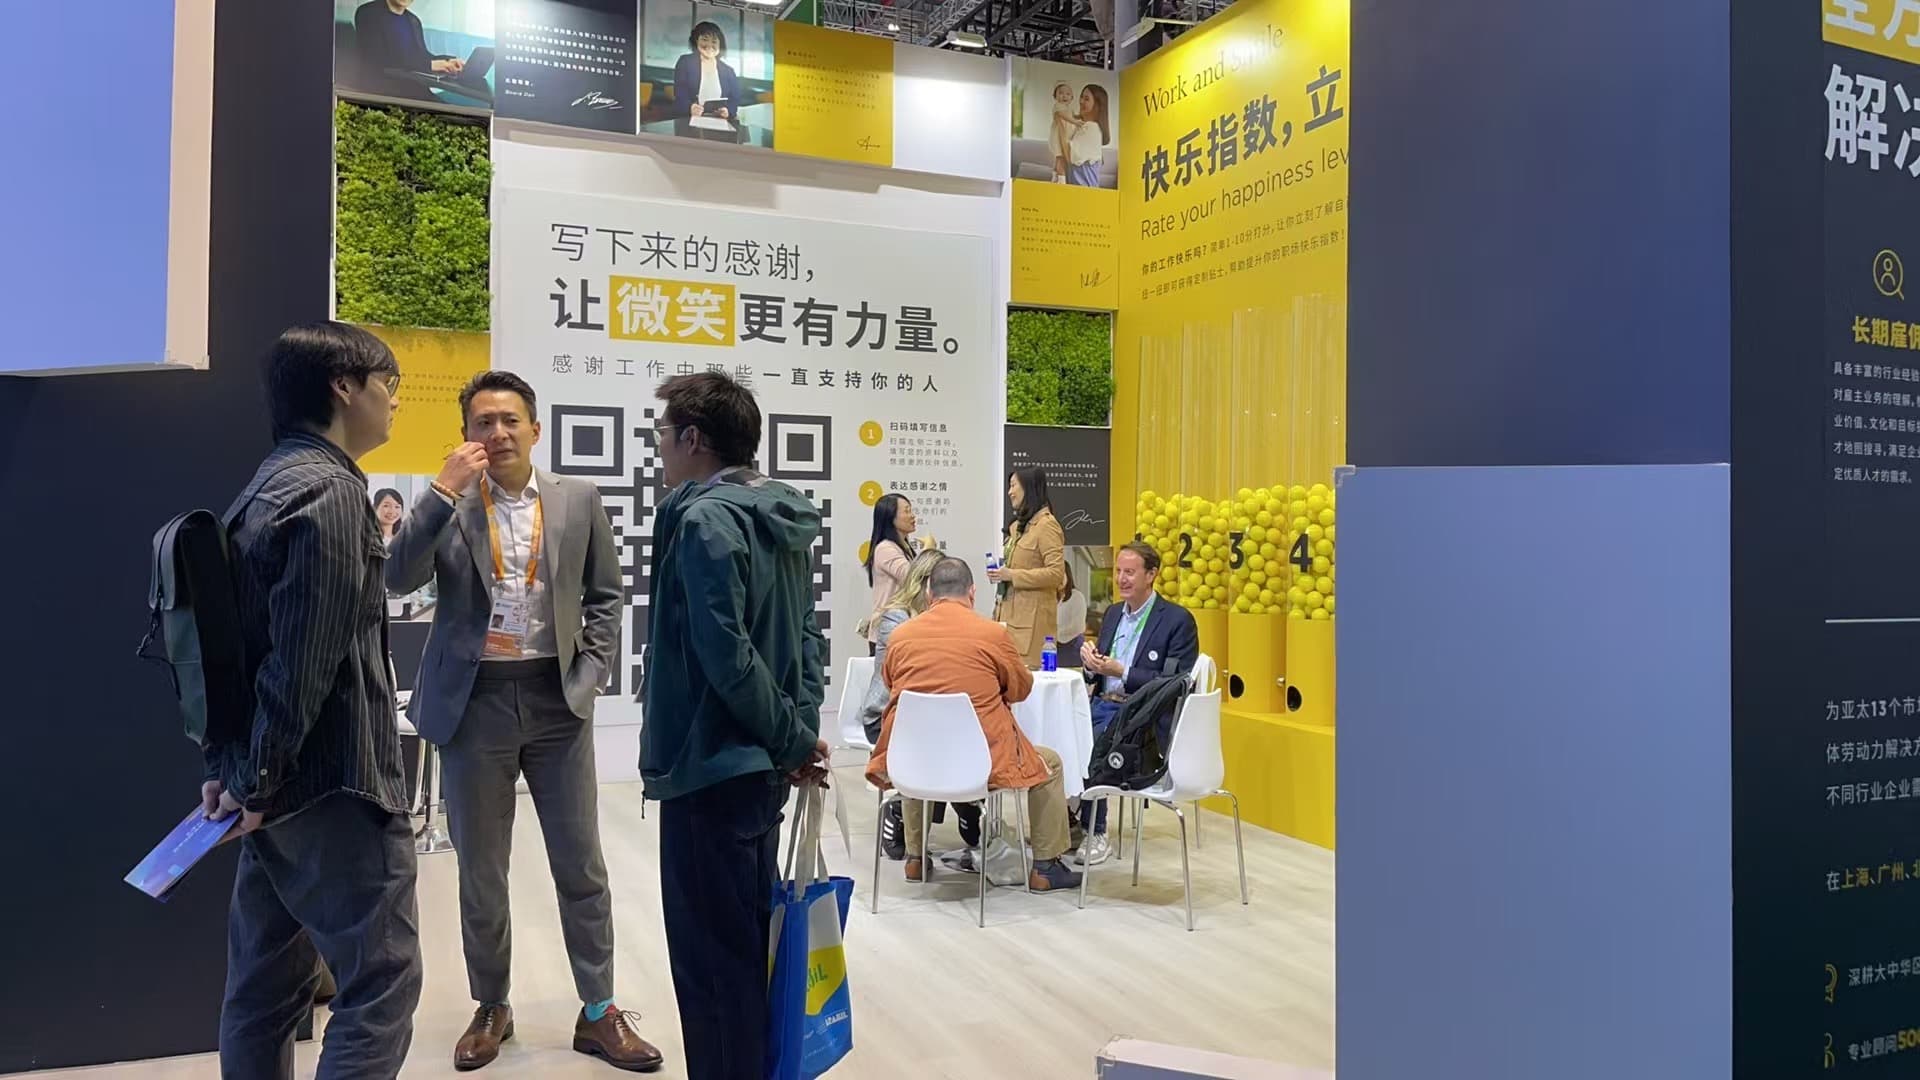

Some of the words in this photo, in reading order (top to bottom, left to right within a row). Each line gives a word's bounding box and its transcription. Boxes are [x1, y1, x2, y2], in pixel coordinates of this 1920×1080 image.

[1143, 75, 1188, 118] Work
[1193, 51, 1225, 93] and
[1231, 24, 1284, 72] Sile
[1141, 65, 1344, 203] 快乐指数，立
[1141, 213, 1175, 240] Rate
[1180, 198, 1217, 232] your
[1222, 159, 1314, 211] happiness
[551, 223, 814, 283] 写下来的感谢，
[550, 277, 960, 355] 让微笑更有力量。
[867, 429, 875, 440] 1
[890, 422, 948, 432] 扫码填写信息
[867, 488, 875, 499] 2
[890, 481, 948, 491] 表达感谢之情
[1179, 532, 1193, 568] 2
[1229, 532, 1244, 569] 3
[1289, 533, 1313, 573] 4
[1826, 696, 1920, 720] 为亚太13个市
[1849, 1028, 1920, 1061] 专业顾问50
